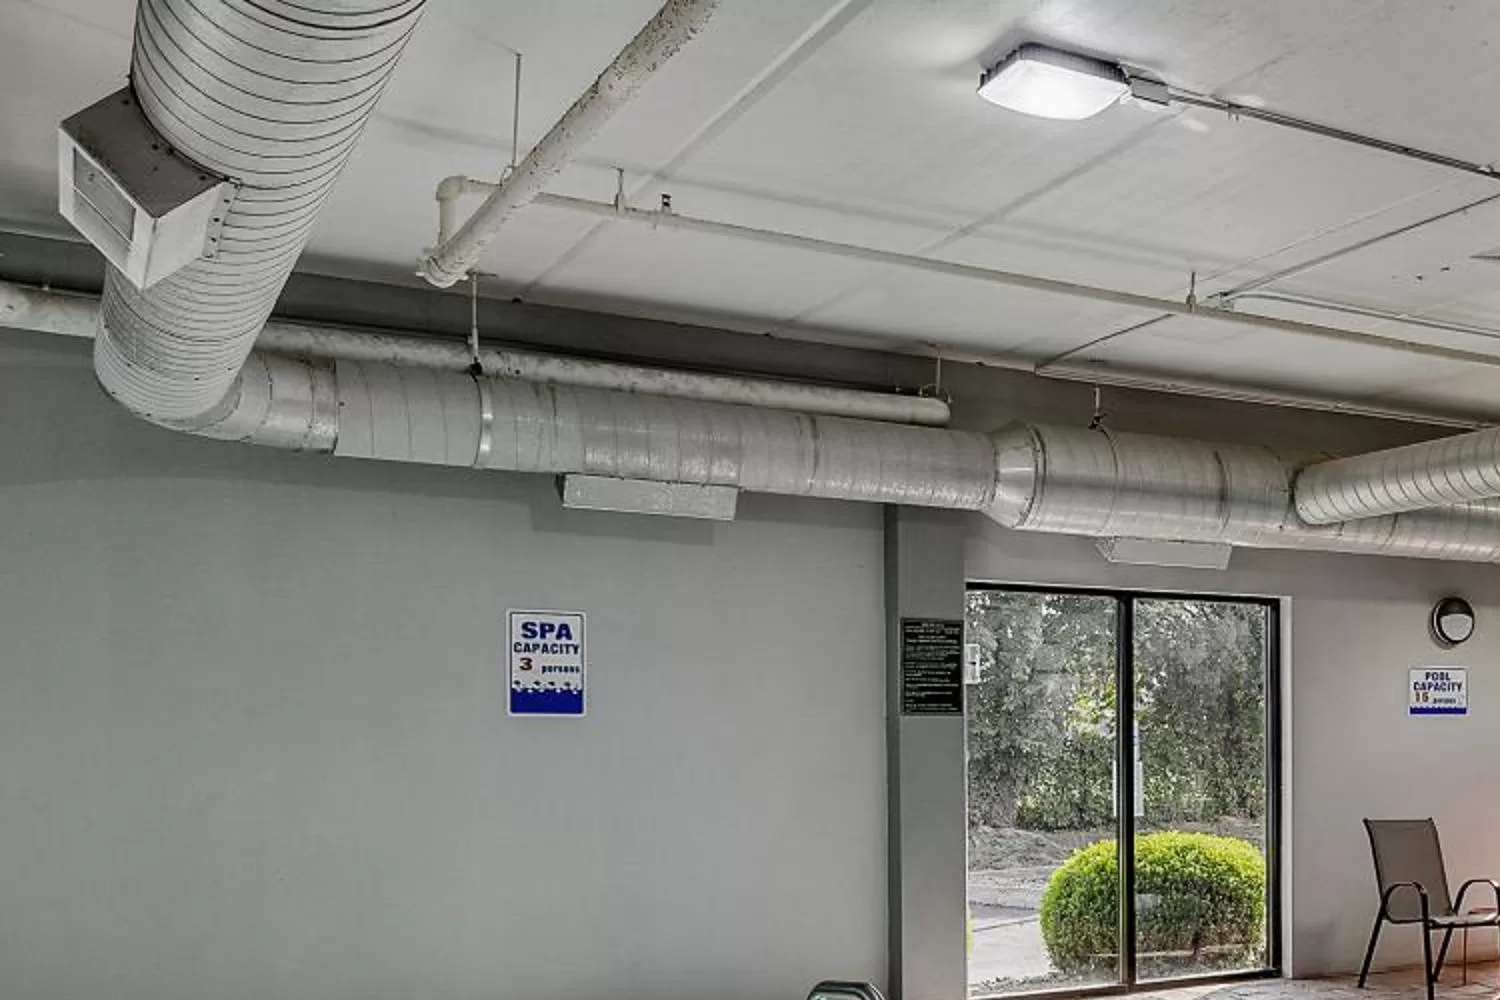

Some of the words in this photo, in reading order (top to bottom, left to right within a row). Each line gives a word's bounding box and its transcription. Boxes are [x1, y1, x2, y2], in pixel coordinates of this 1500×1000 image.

[521, 621, 573, 641] SPA
[513, 642, 580, 655] CAPACITY
[519, 657, 533, 671] 3
[1425, 671, 1451, 681] POOL
[1413, 681, 1463, 693] CAPACITY
